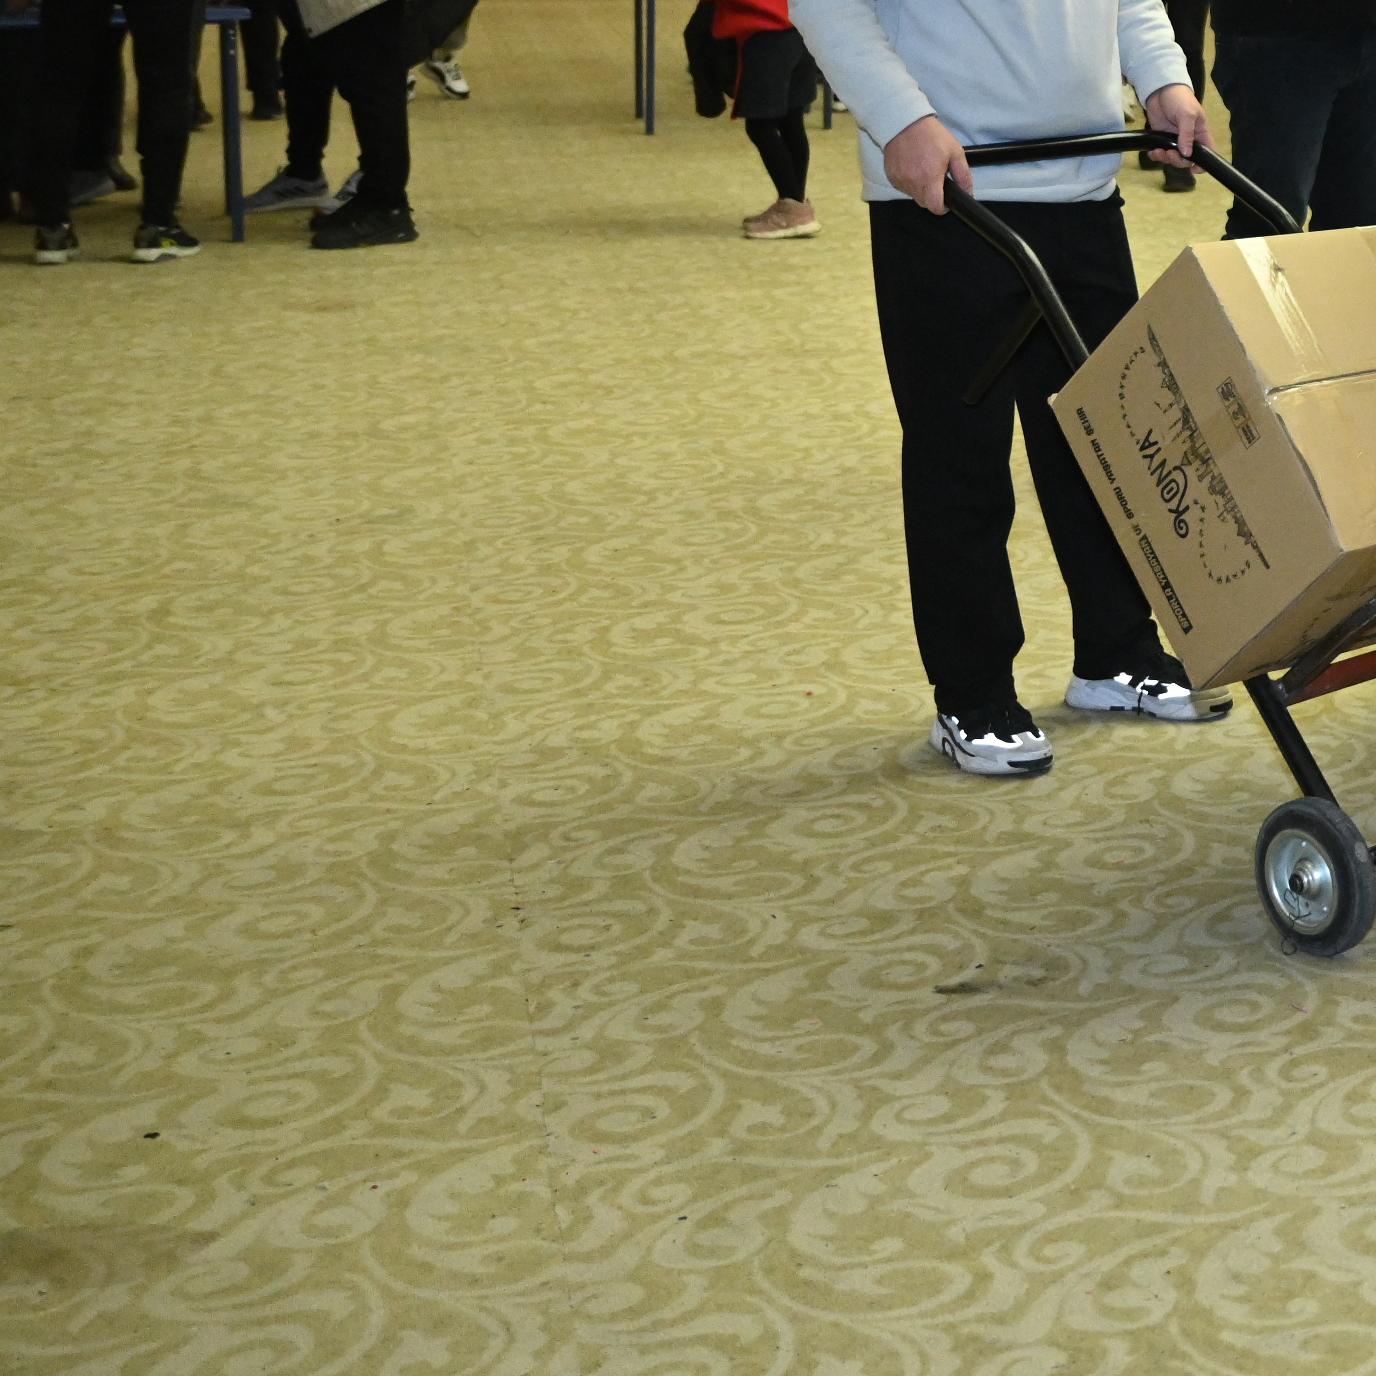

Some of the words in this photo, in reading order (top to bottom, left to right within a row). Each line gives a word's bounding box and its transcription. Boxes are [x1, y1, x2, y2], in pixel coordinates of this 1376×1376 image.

[1090, 439, 1117, 485] YAŞATAN
[1138, 428, 1191, 538] KONYA
[1113, 486, 1135, 520] SPORU
[1140, 538, 1166, 587] YAŞAYAN
[1164, 587, 1192, 631] SPORLA
